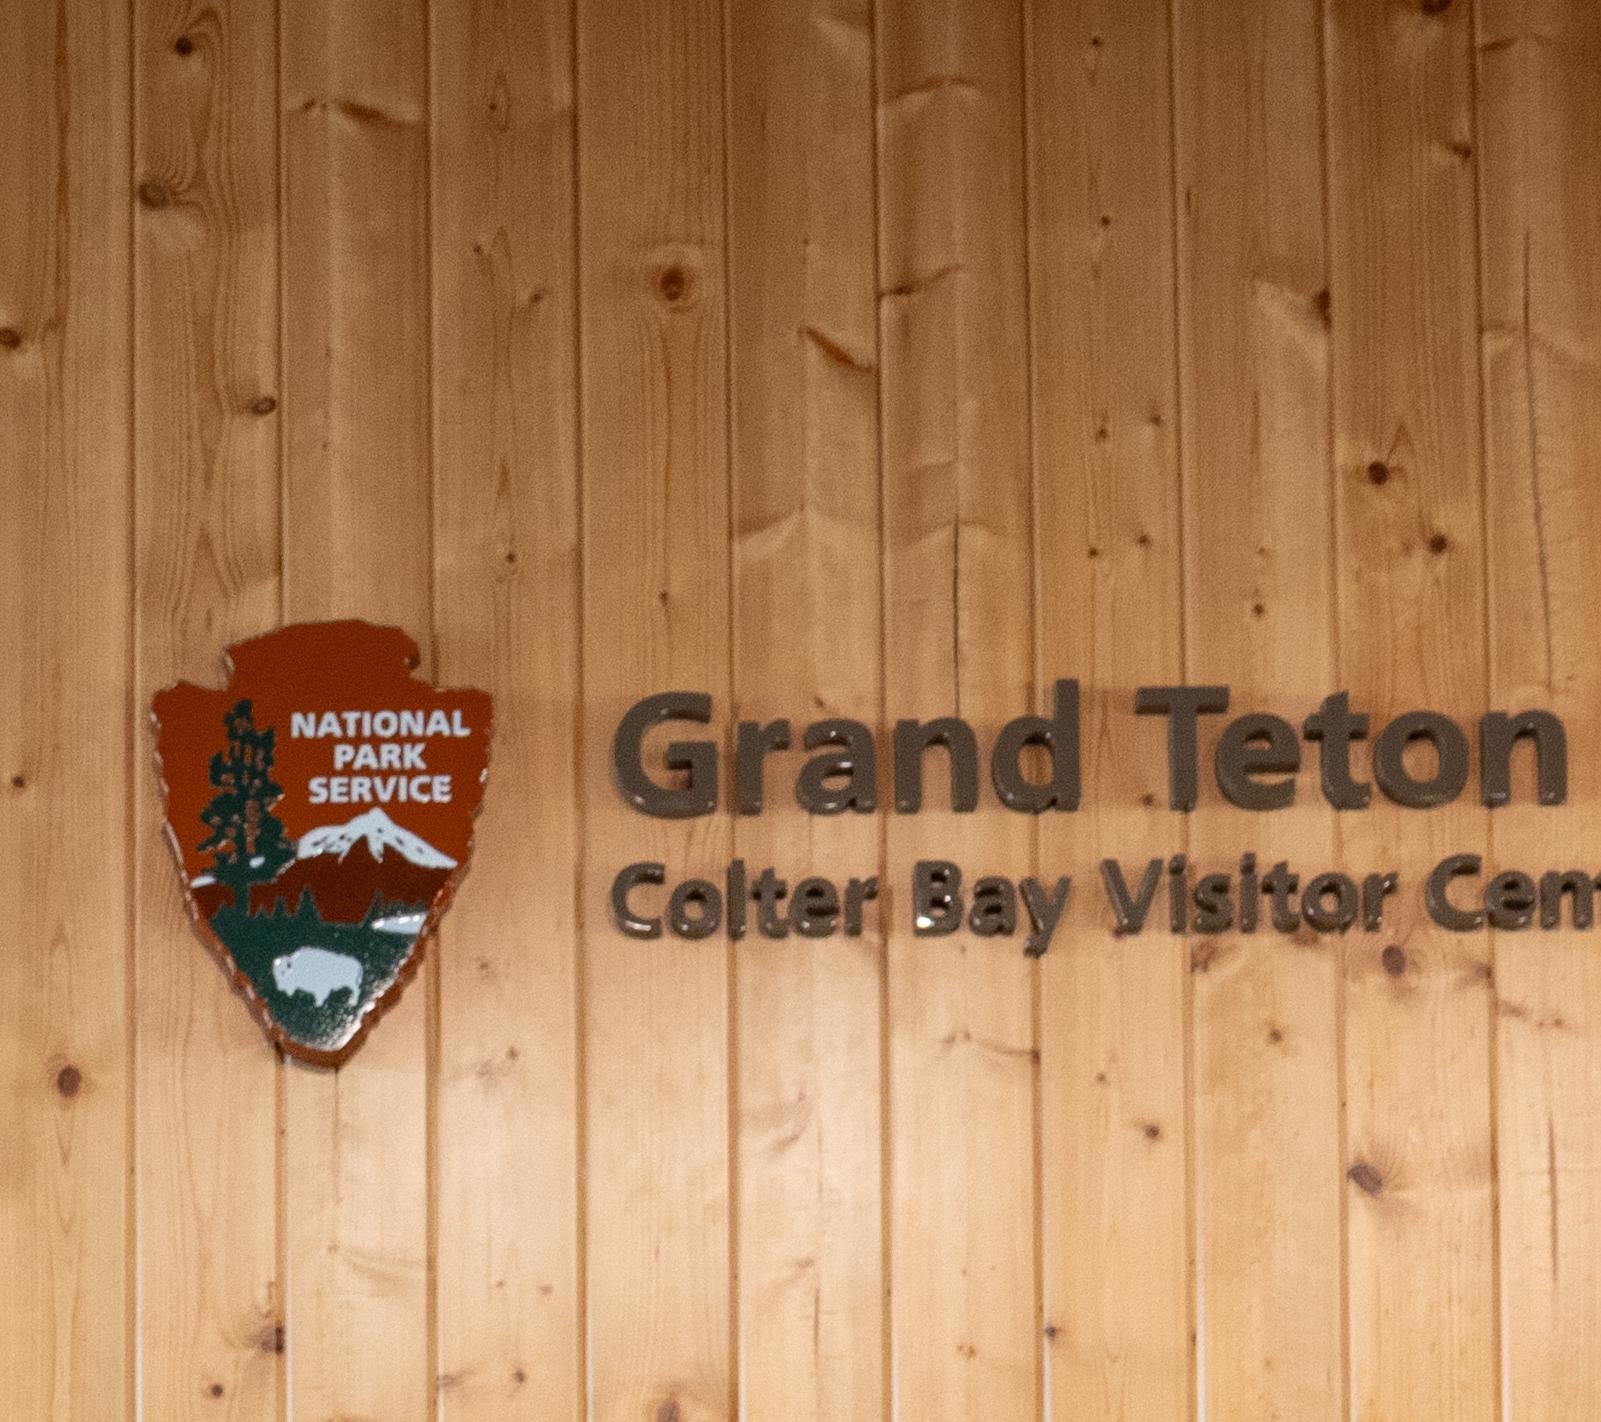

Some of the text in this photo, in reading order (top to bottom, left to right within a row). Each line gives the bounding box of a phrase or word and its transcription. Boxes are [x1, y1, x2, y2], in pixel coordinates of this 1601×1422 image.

[290, 709, 472, 738] NATIONAL
[333, 742, 427, 770] PARK
[611, 679, 1081, 820] Grand
[1134, 685, 1568, 813] Teton
[308, 775, 452, 804] SERVICE
[610, 858, 879, 941] Colter
[912, 860, 1072, 959] Bay
[1099, 852, 1398, 935] Visitor
